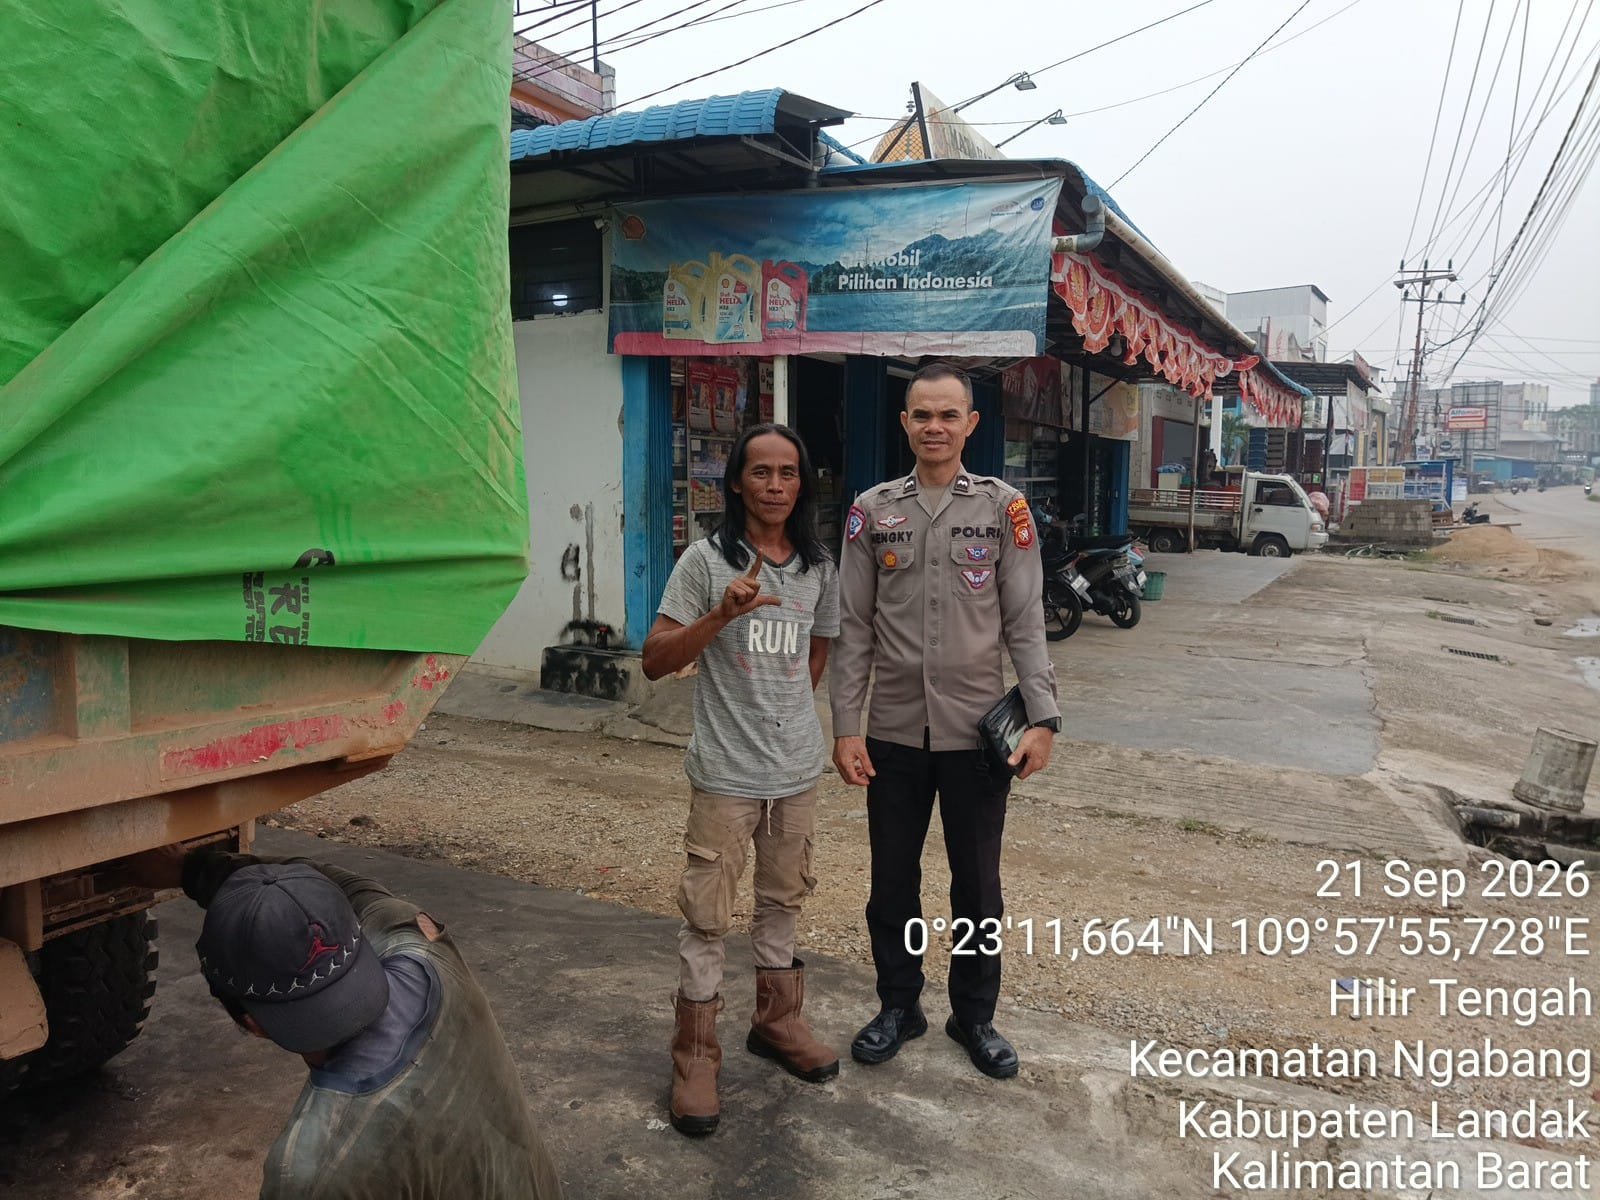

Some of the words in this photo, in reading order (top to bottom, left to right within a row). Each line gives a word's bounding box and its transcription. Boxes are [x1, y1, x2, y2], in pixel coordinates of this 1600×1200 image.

[838, 272, 897, 290] Pilihan
[903, 270, 993, 289] Indonesia
[666, 298, 687, 306] HELIX
[719, 296, 743, 304] HELIX
[951, 526, 1004, 539] POLRI
[748, 618, 799, 654] RUN
